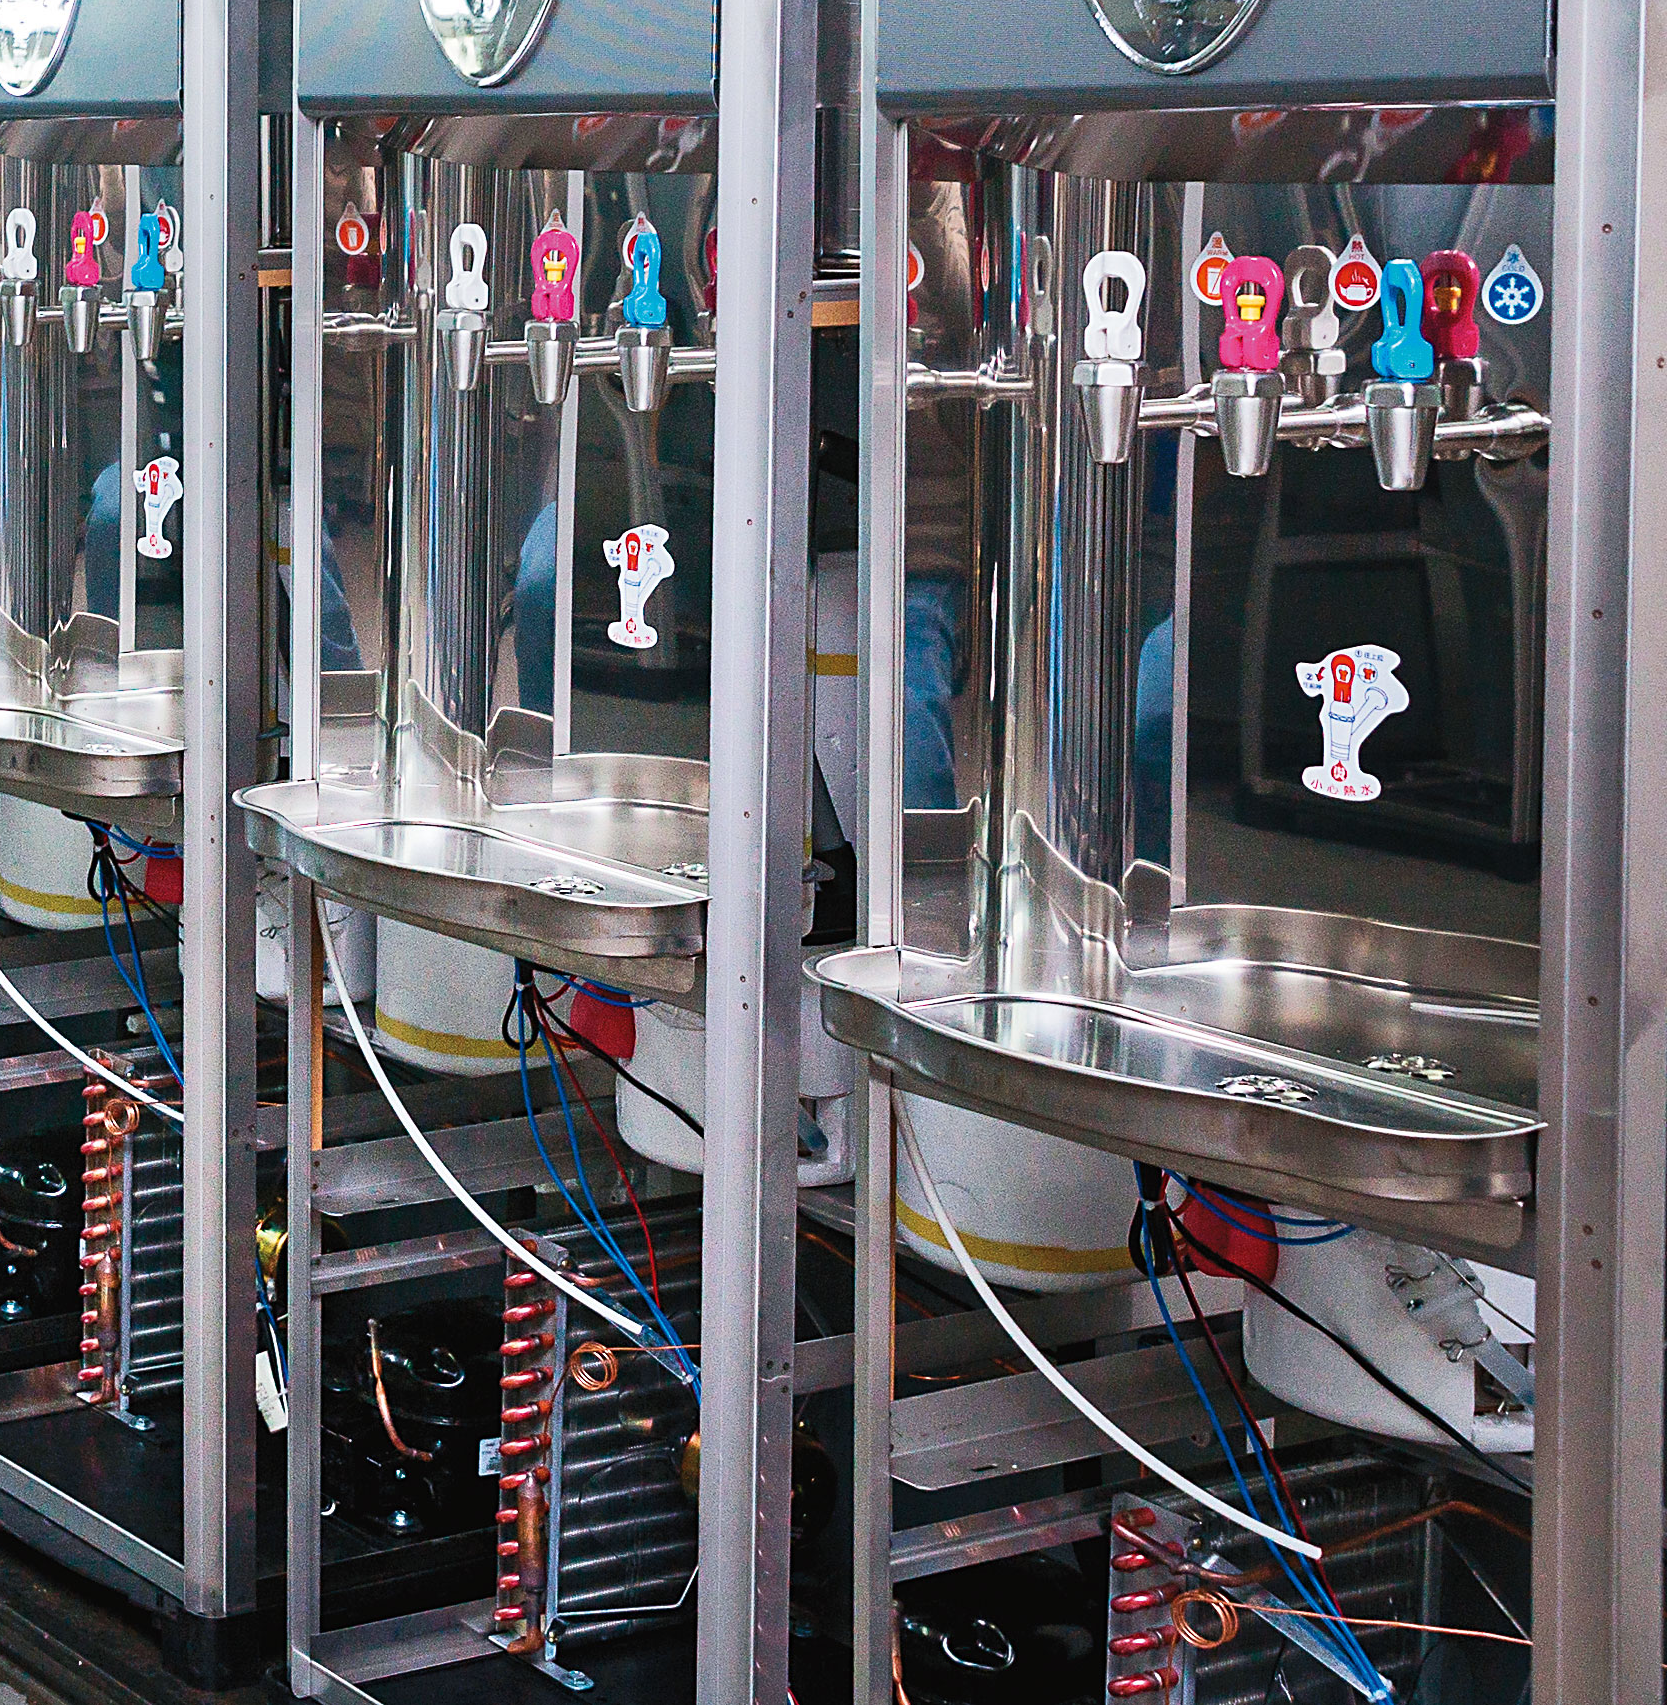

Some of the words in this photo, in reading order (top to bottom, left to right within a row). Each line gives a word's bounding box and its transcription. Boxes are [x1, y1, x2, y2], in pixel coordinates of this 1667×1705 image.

[1207, 249, 1229, 257] WARM
[1501, 264, 1526, 272] COLD
[1310, 779, 1374, 797] 小心熱水
